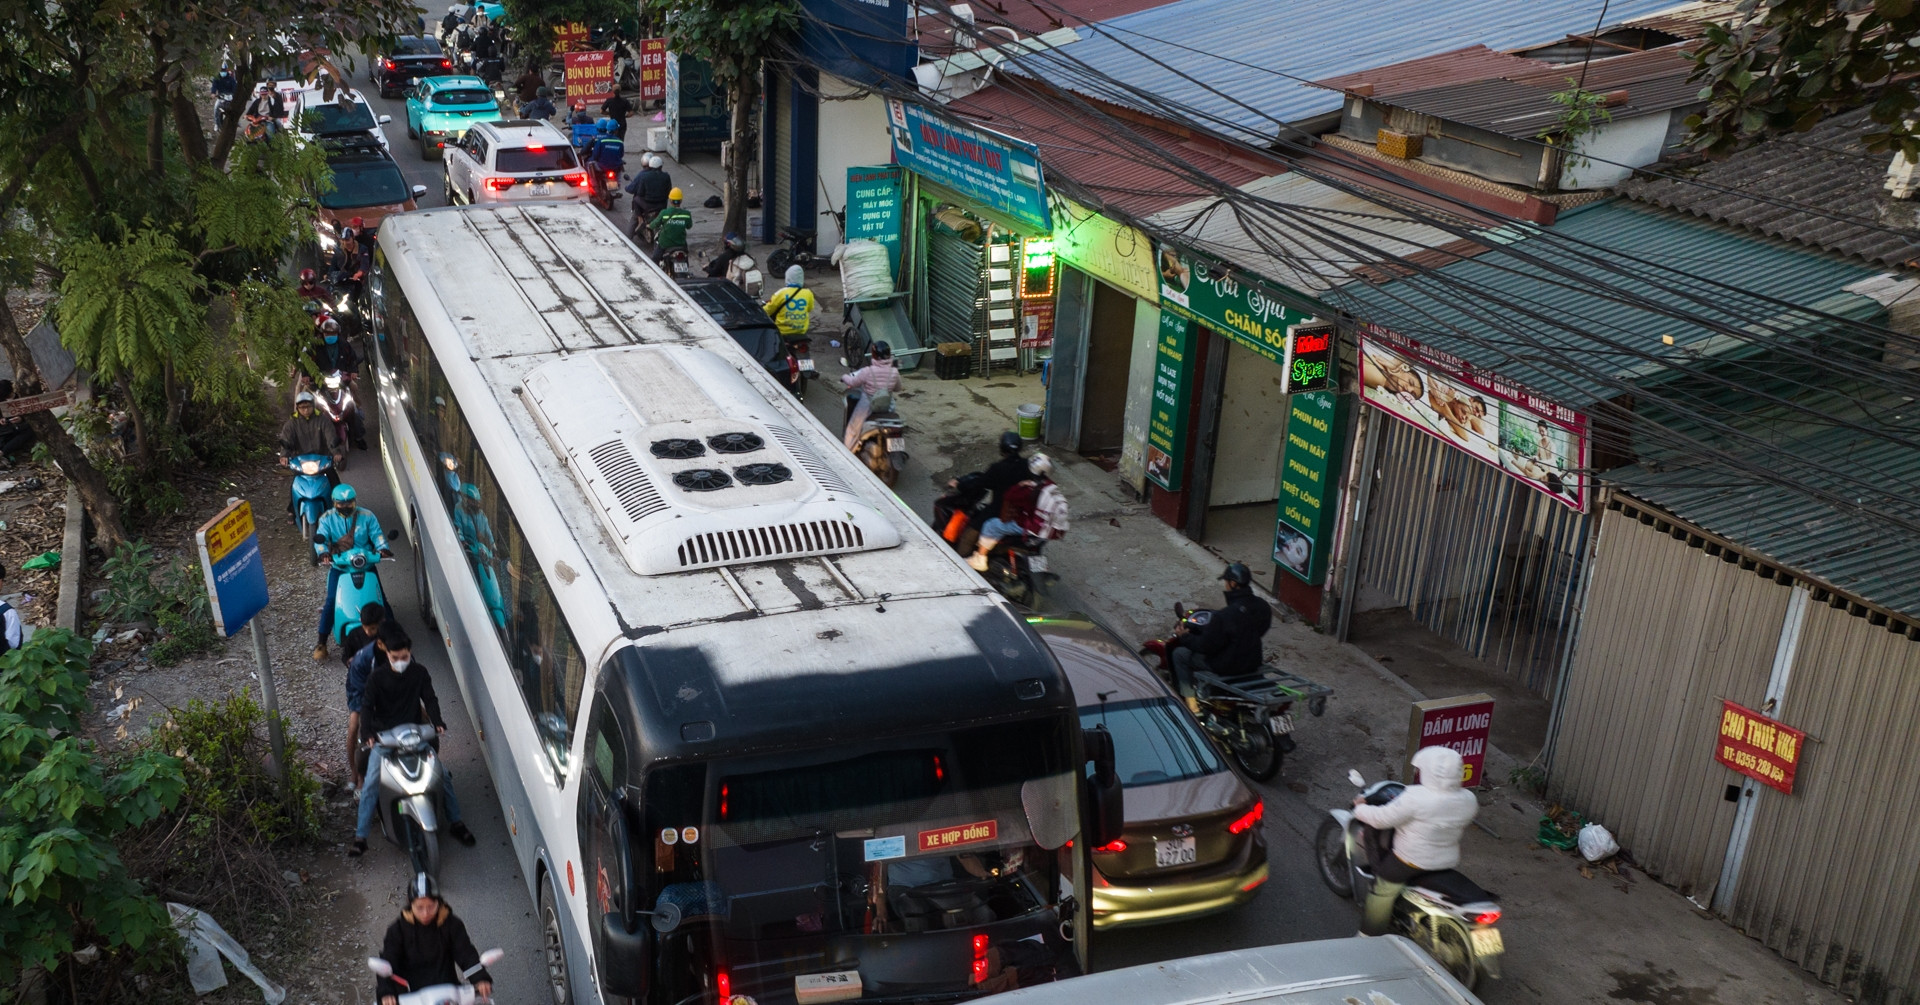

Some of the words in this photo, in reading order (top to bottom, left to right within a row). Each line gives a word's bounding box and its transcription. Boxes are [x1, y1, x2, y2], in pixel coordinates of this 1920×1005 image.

[554, 40, 569, 53] XE
[643, 54, 653, 65] XE
[653, 53, 662, 65] GA
[567, 65, 583, 79] BÚN
[584, 66, 595, 78] BÒ
[596, 61, 612, 77] HUẾ
[568, 82, 583, 97] BÚN
[584, 81, 595, 95] CÁ
[984, 148, 1003, 174] ĐẠT
[856, 188, 876, 199] CUNG
[877, 185, 894, 196] CẤP:
[862, 201, 877, 210] MÁY
[878, 199, 894, 208] MÓC
[862, 211, 881, 222] DỤNG
[881, 210, 891, 220] CỤ
[862, 222, 874, 233] VẬT
[875, 221, 885, 231] TƯ
[785, 294, 807, 311] be
[1224, 308, 1262, 339] CHĂM
[1292, 358, 1326, 386] Spa
[1292, 407, 1312, 425] PHUN
[1313, 417, 1328, 433] MÔI
[1289, 433, 1308, 451] PHUN
[1289, 459, 1308, 477] PHUN
[1283, 480, 1300, 497] TRIỆT
[1300, 490, 1320, 509] LÔNG
[1285, 506, 1301, 522] UỐN
[1423, 713, 1454, 737] ĐẤM
[1455, 712, 1490, 732] LƯNG
[1721, 709, 1746, 741] CHO
[1747, 719, 1776, 753] THUÊ
[1735, 750, 1757, 770] 0355
[1756, 758, 1772, 777] 288
[926, 834, 939, 846] XE
[942, 830, 961, 846] HỢP
[963, 825, 990, 840] ĐỒNG
